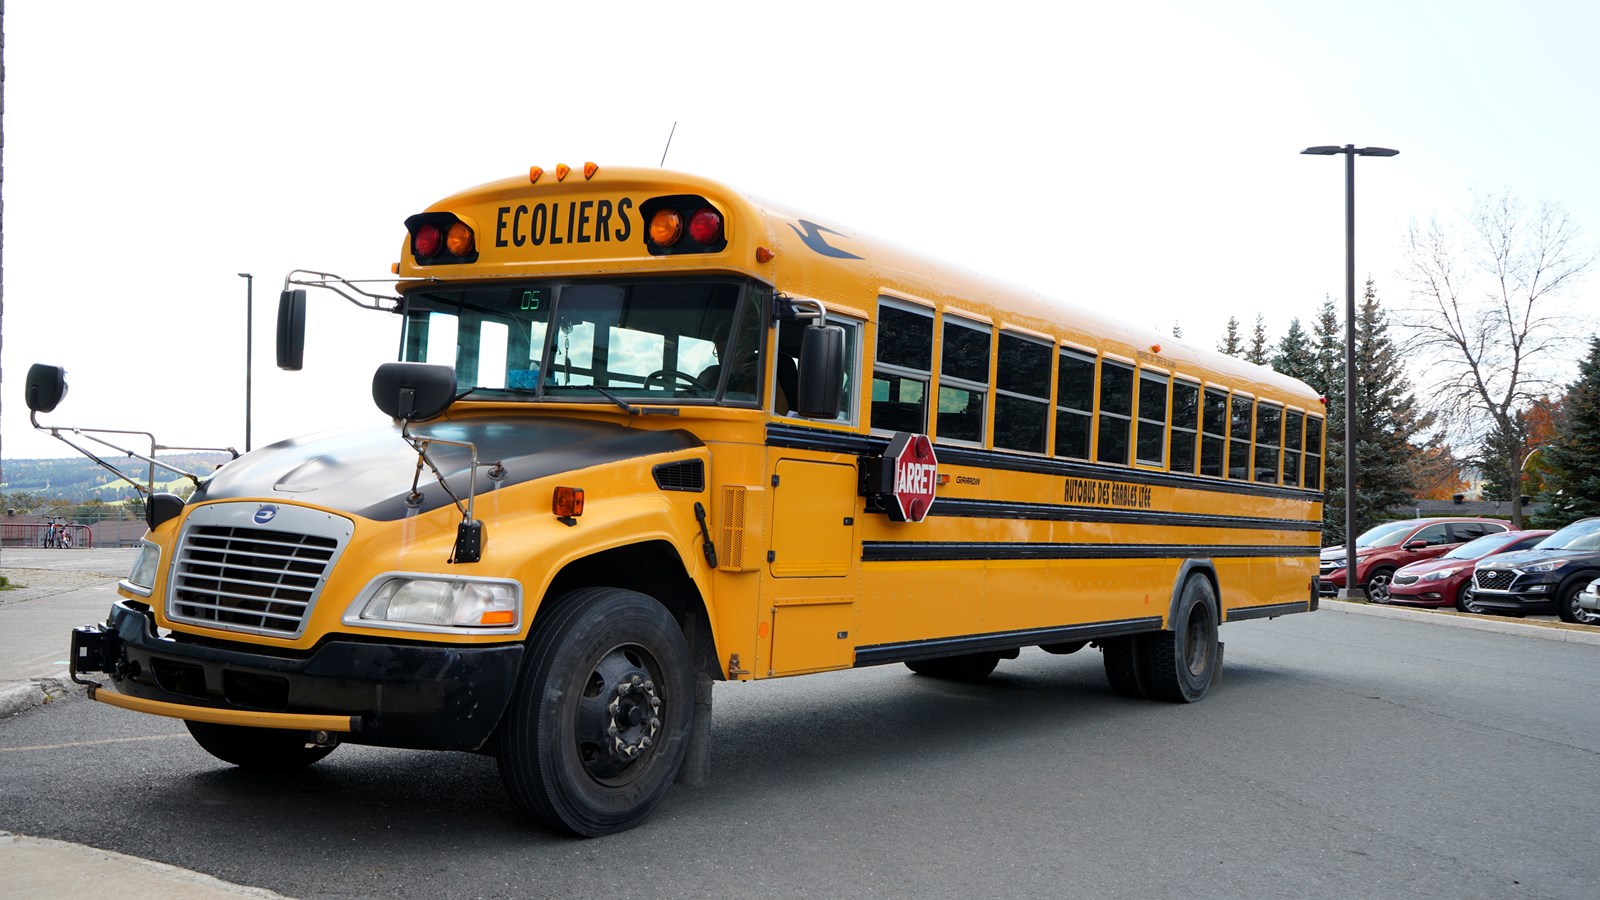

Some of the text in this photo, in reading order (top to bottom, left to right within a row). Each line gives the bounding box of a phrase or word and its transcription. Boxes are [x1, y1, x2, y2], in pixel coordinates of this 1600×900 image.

[495, 197, 633, 248] ECOLIERS
[520, 290, 541, 310] 05
[898, 461, 936, 495] ARRET
[956, 475, 981, 486] GIRARDIN
[1064, 478, 1096, 504] AUTOBUS
[1097, 481, 1110, 505] DES
[1138, 484, 1151, 509] LTÉE
